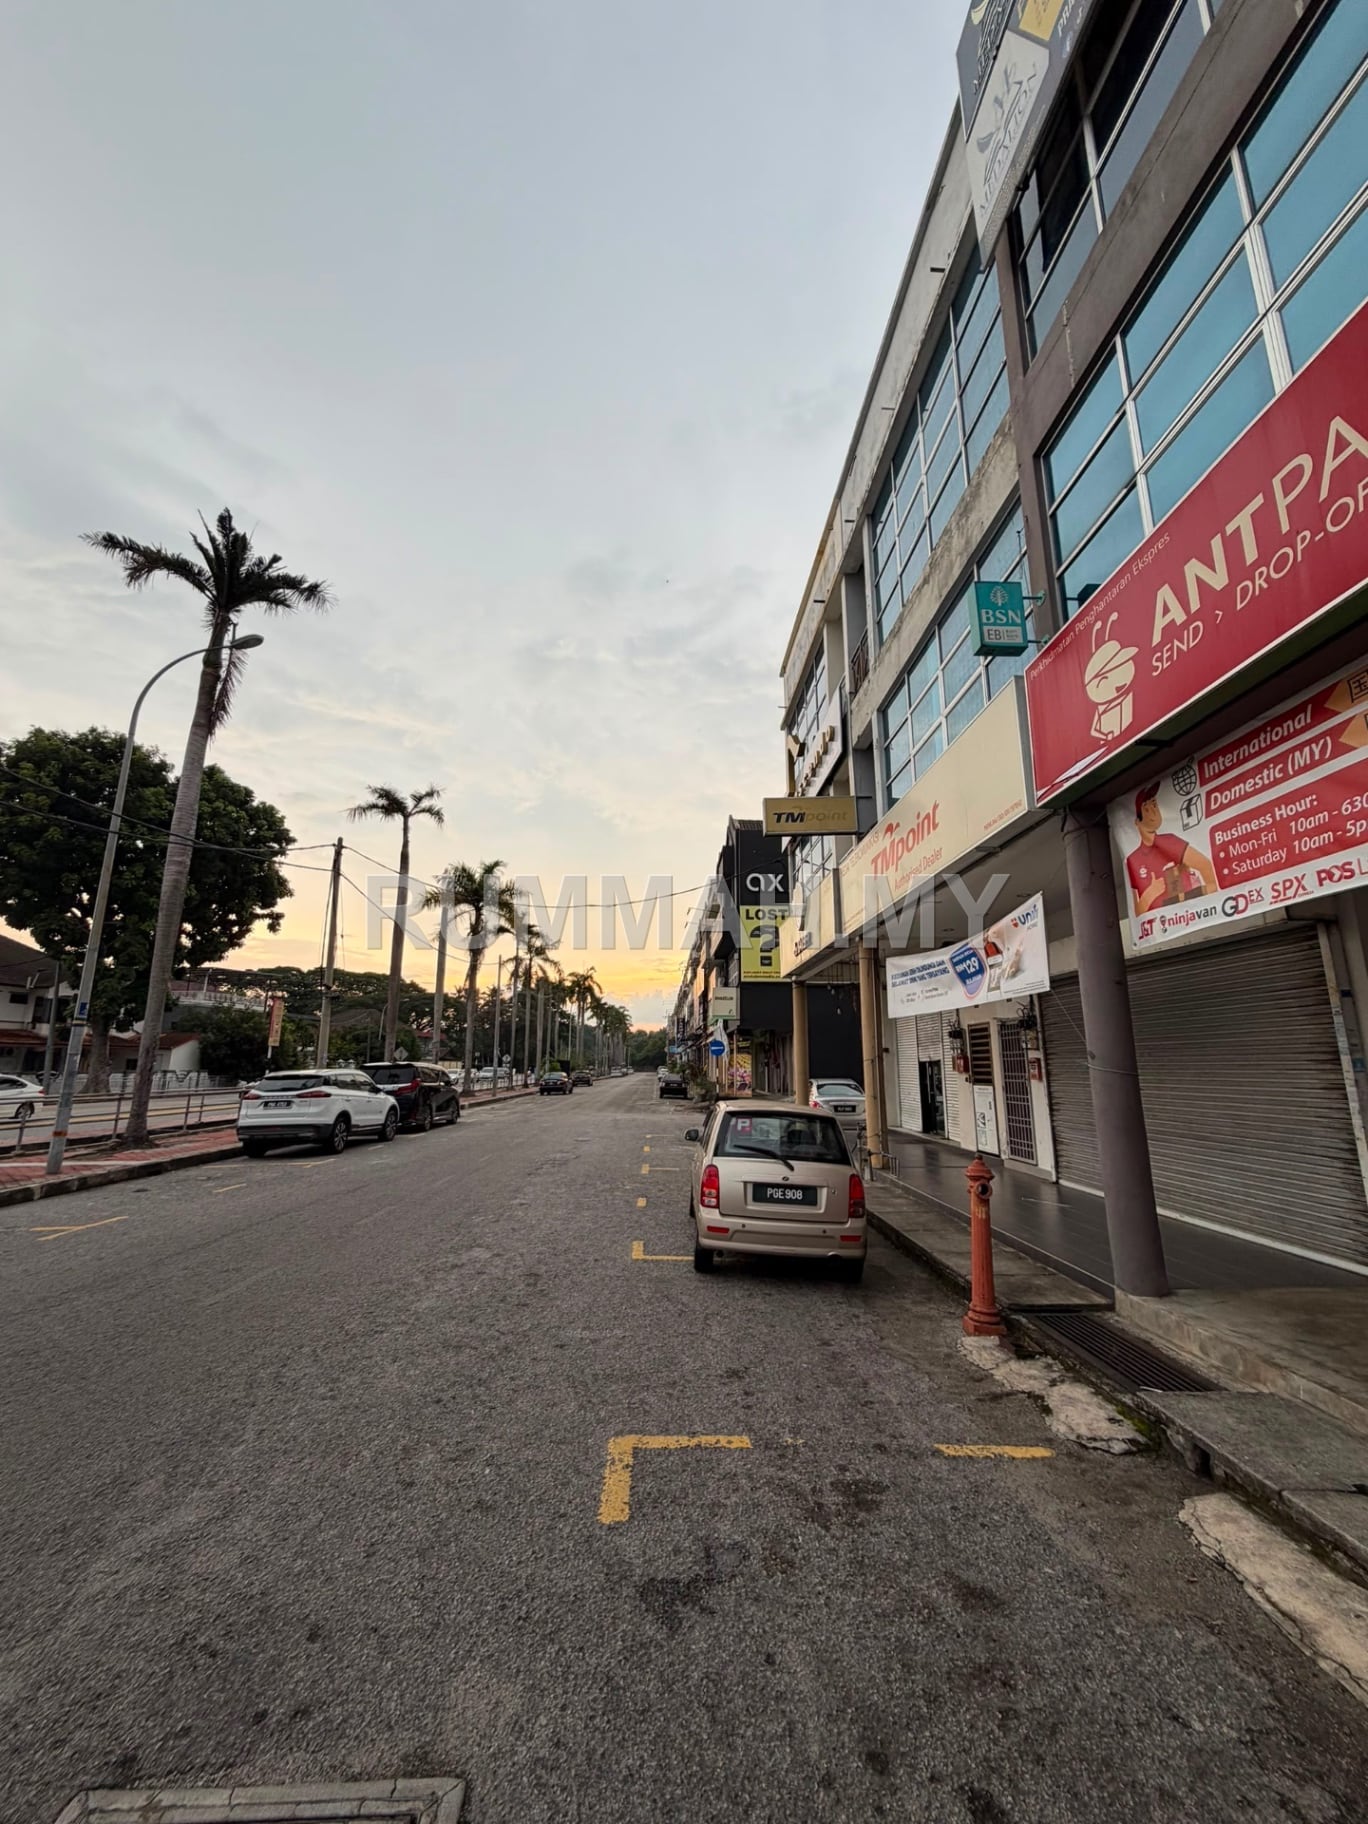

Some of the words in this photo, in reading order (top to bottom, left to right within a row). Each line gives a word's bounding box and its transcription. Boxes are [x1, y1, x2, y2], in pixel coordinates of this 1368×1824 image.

[981, 609, 1021, 623] BSN
[1030, 632, 1075, 680] Perkhidmatan
[1075, 573, 1131, 635] Penghantaran
[1132, 532, 1170, 576] Ekspres
[1152, 621, 1204, 676] SEND
[1204, 704, 1313, 778] International
[1210, 763, 1284, 810] Domestic
[1287, 736, 1332, 776] (MY)
[1215, 813, 1273, 845] Business
[1275, 794, 1318, 821] Hour:
[1229, 828, 1277, 858] Mon-Fri
[1290, 811, 1329, 834] 10am
[1232, 847, 1287, 876] Saturday
[1293, 830, 1334, 854] 10am
[1346, 819, 1368, 837] 5p
[1271, 873, 1307, 899] SPX
[1315, 861, 1355, 887] POS
[745, 909, 788, 920] LOST
